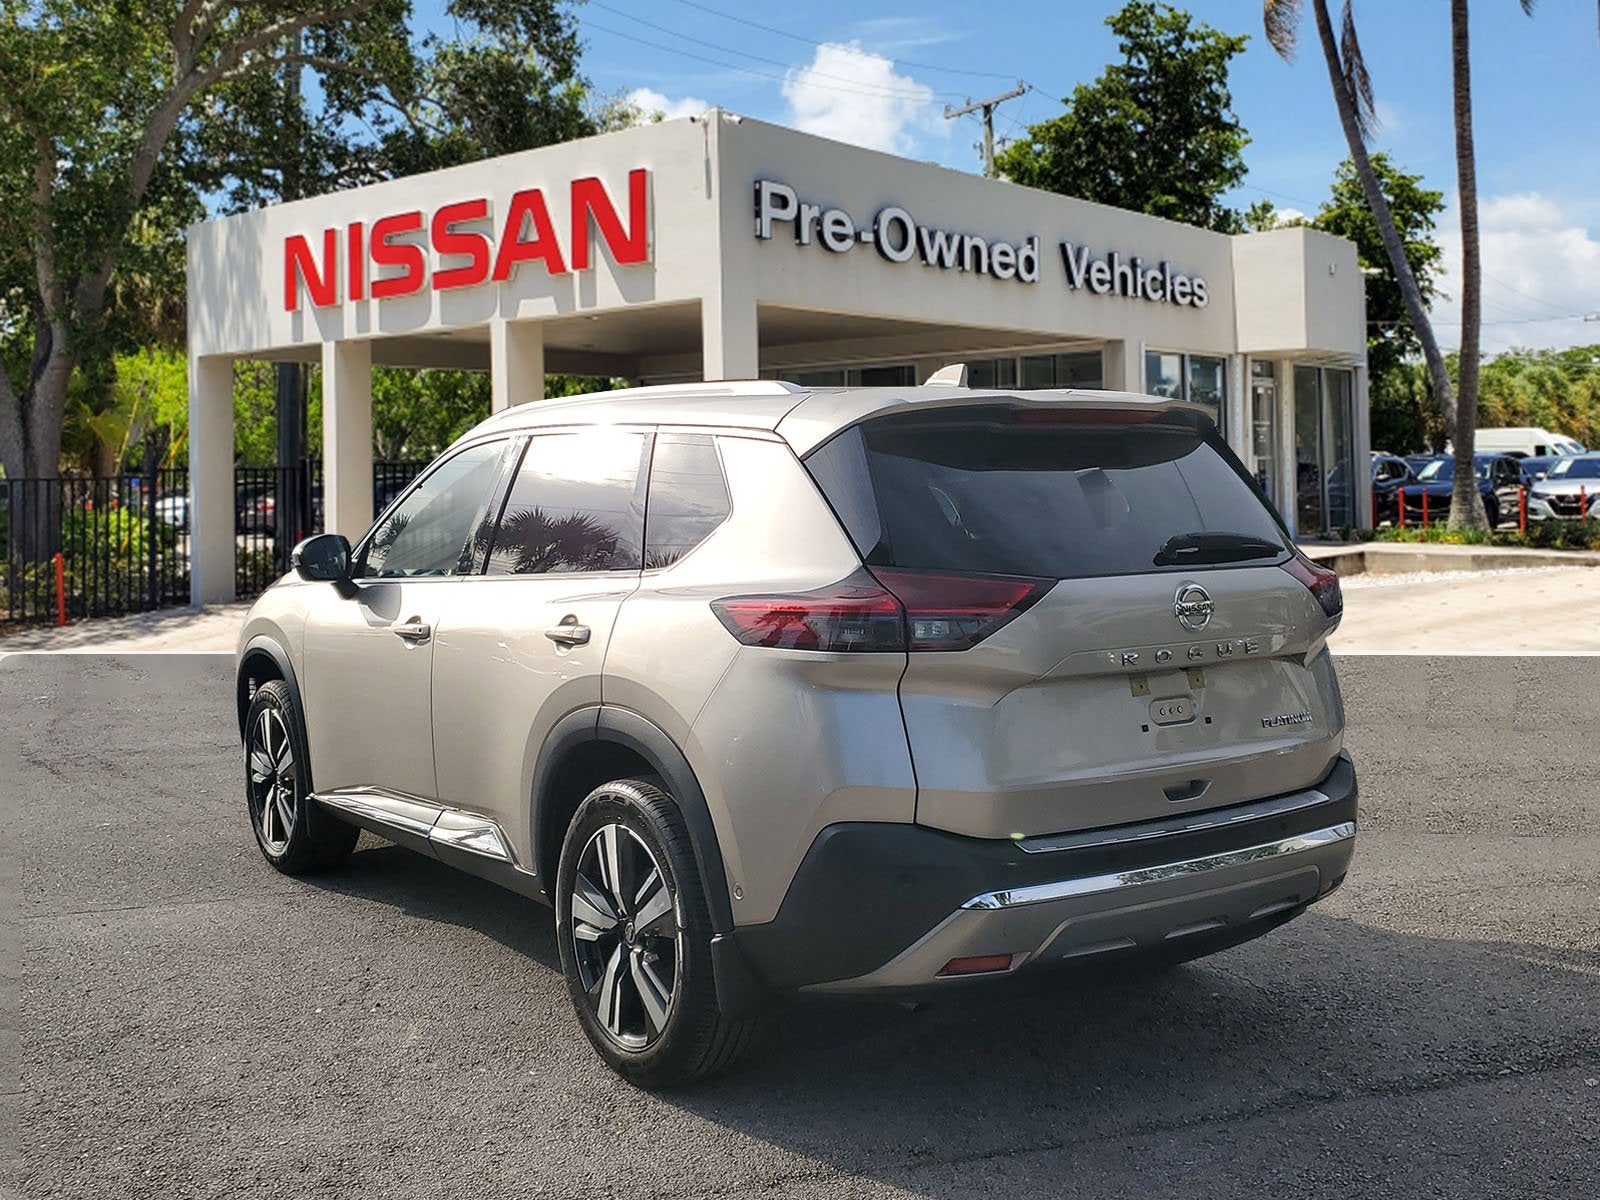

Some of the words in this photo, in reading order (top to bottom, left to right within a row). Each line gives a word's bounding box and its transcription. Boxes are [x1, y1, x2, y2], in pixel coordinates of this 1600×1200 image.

[284, 169, 647, 312] NISSAN
[754, 180, 1040, 284] Pre-Owned
[1060, 240, 1209, 308] Vehicles
[1181, 602, 1213, 614] NISSAN
[1121, 638, 1260, 667] ROGUE
[1261, 711, 1312, 728] PLATINUM
